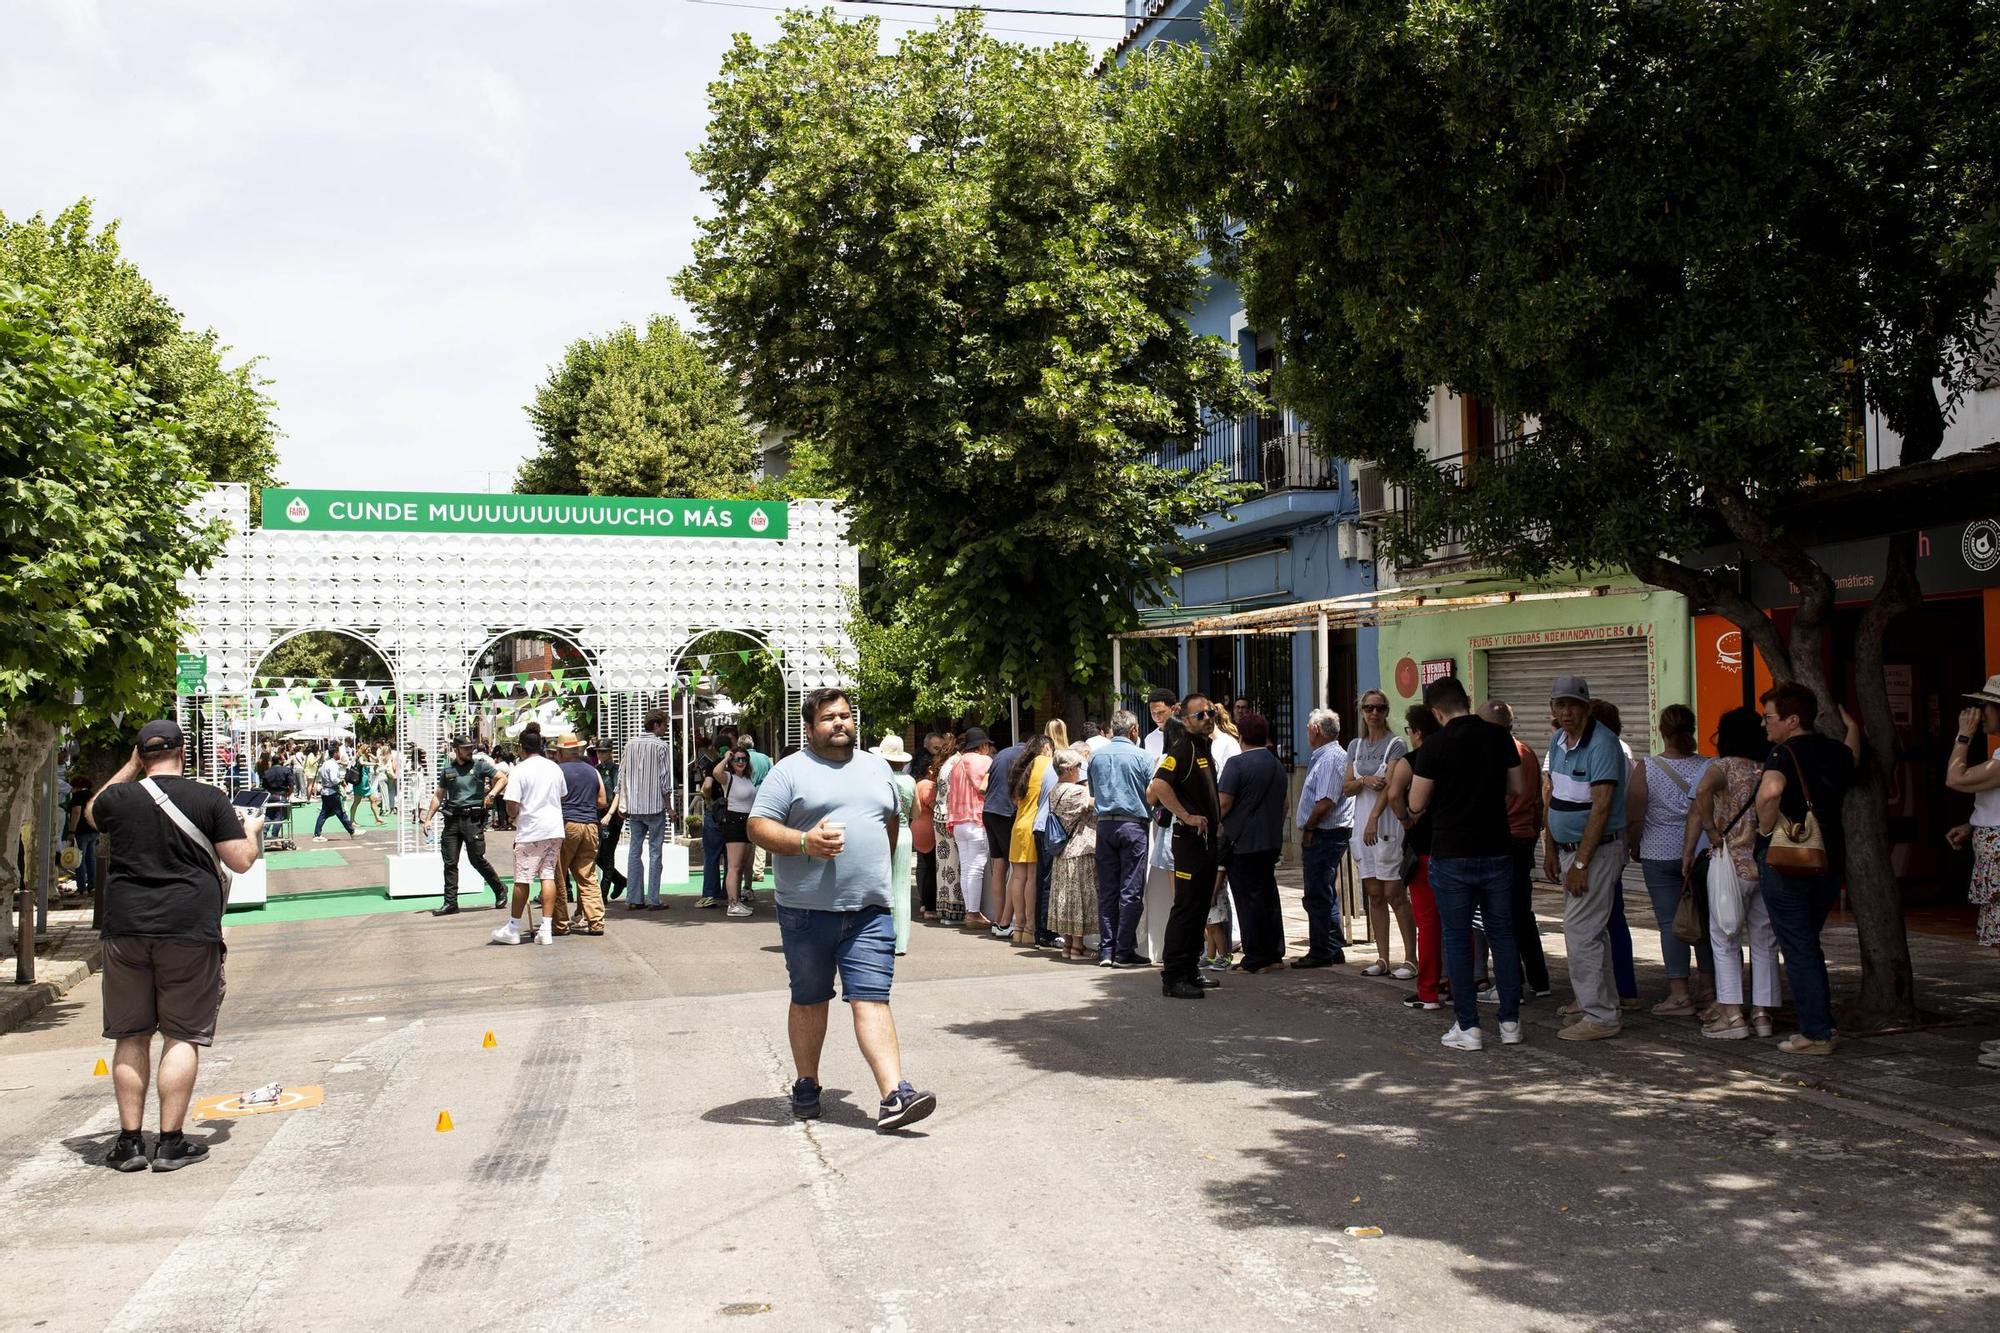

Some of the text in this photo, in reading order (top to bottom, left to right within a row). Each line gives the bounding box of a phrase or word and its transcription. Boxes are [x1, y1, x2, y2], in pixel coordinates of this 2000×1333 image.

[289, 507, 307, 517] FAIRY
[328, 501, 733, 528] CUNDE MUUUUUUUUUUCHO MÁS
[751, 515, 767, 526] FAIRY
[1832, 574, 1875, 590] omáticas
[1469, 637, 1493, 649] FRUTAS
[1495, 636, 1499, 646] Y
[1503, 632, 1541, 645] VERDURAS
[1426, 662, 1446, 674] VENDE
